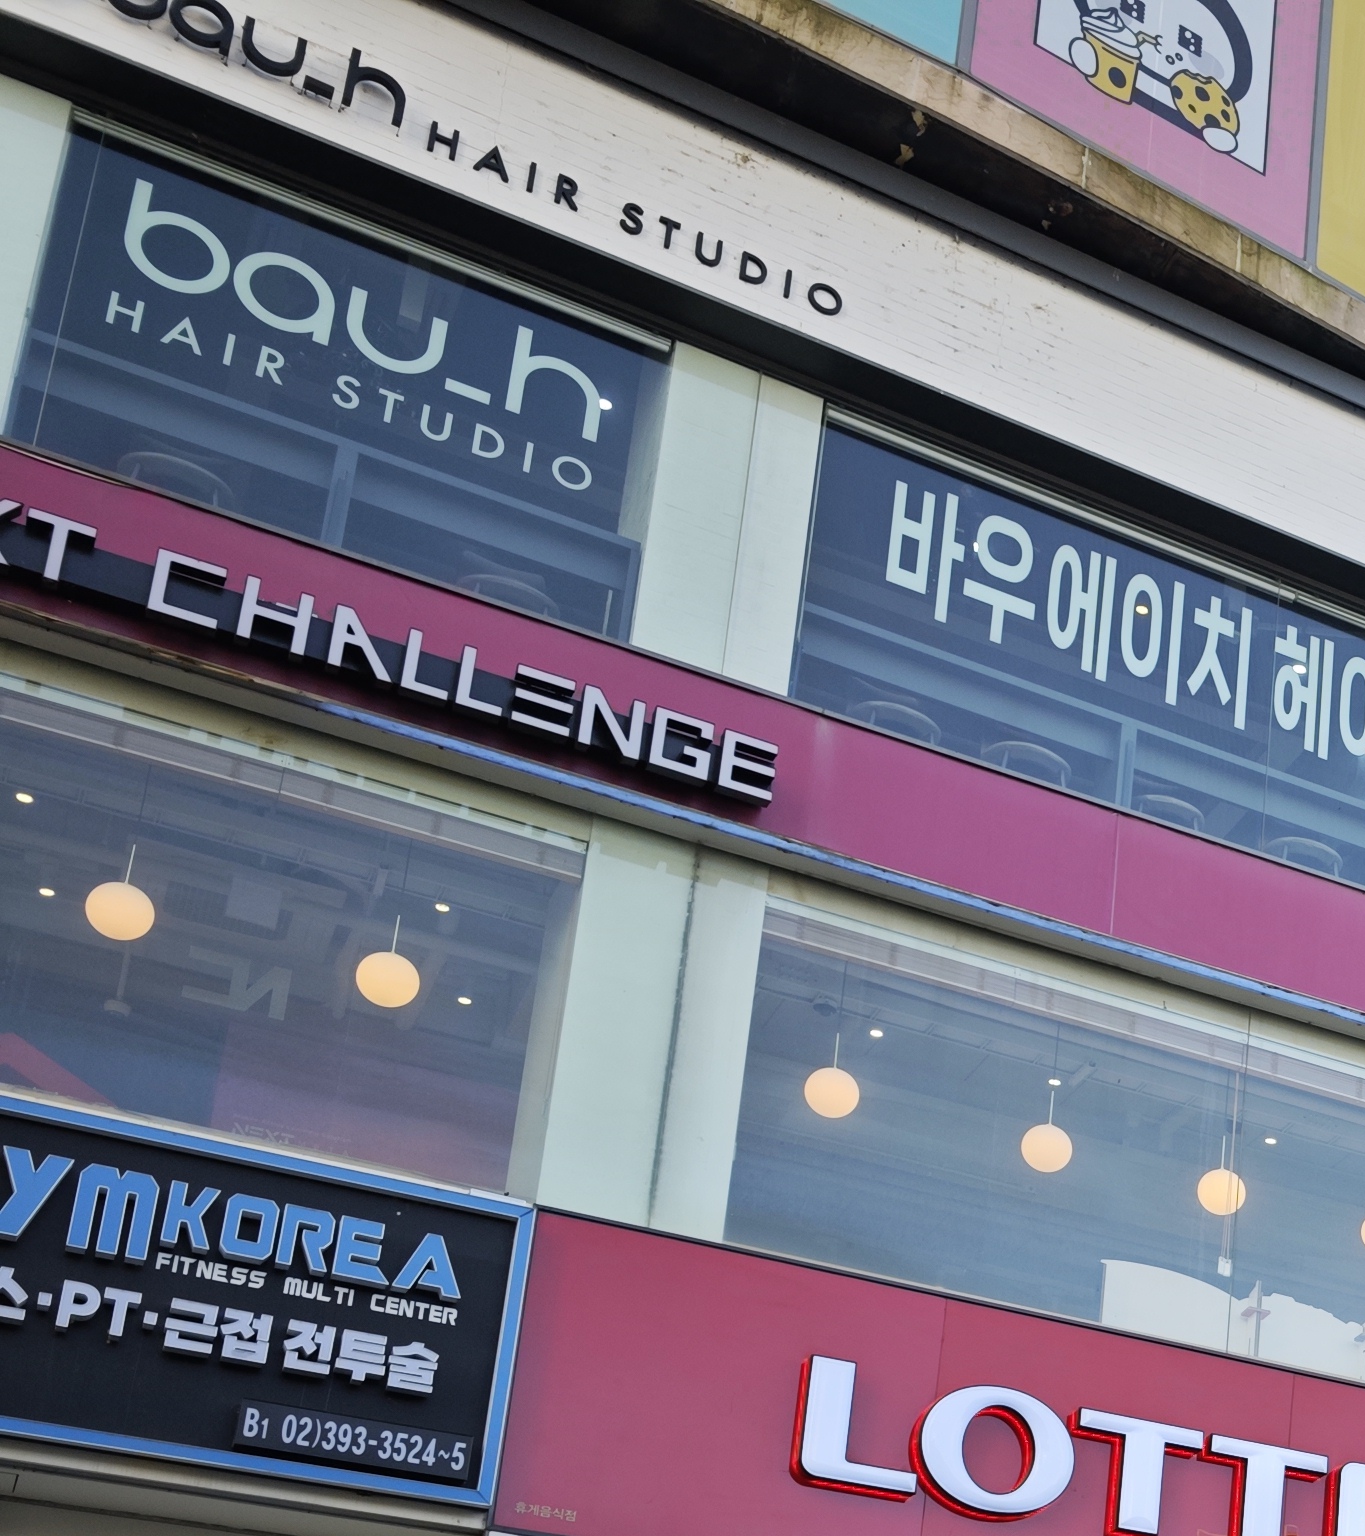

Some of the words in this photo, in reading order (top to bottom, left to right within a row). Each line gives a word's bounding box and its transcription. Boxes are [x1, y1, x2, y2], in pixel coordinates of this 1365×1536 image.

[427, 120, 580, 212] HAIR
[620, 202, 843, 315] STUDIO
[124, 177, 601, 443] bau_h
[105, 291, 284, 387] HAIR
[331, 374, 593, 491] STUDIO
[886, 479, 1253, 731] 바우에이치
[156, 1252, 267, 1290] FITNESS
[283, 1276, 354, 1307] MULTI
[369, 1294, 458, 1326] CENTER
[282, 1318, 439, 1394] 전투술
[242, 1407, 269, 1440] B1
[514, 1501, 577, 1521] 휴게음식점
